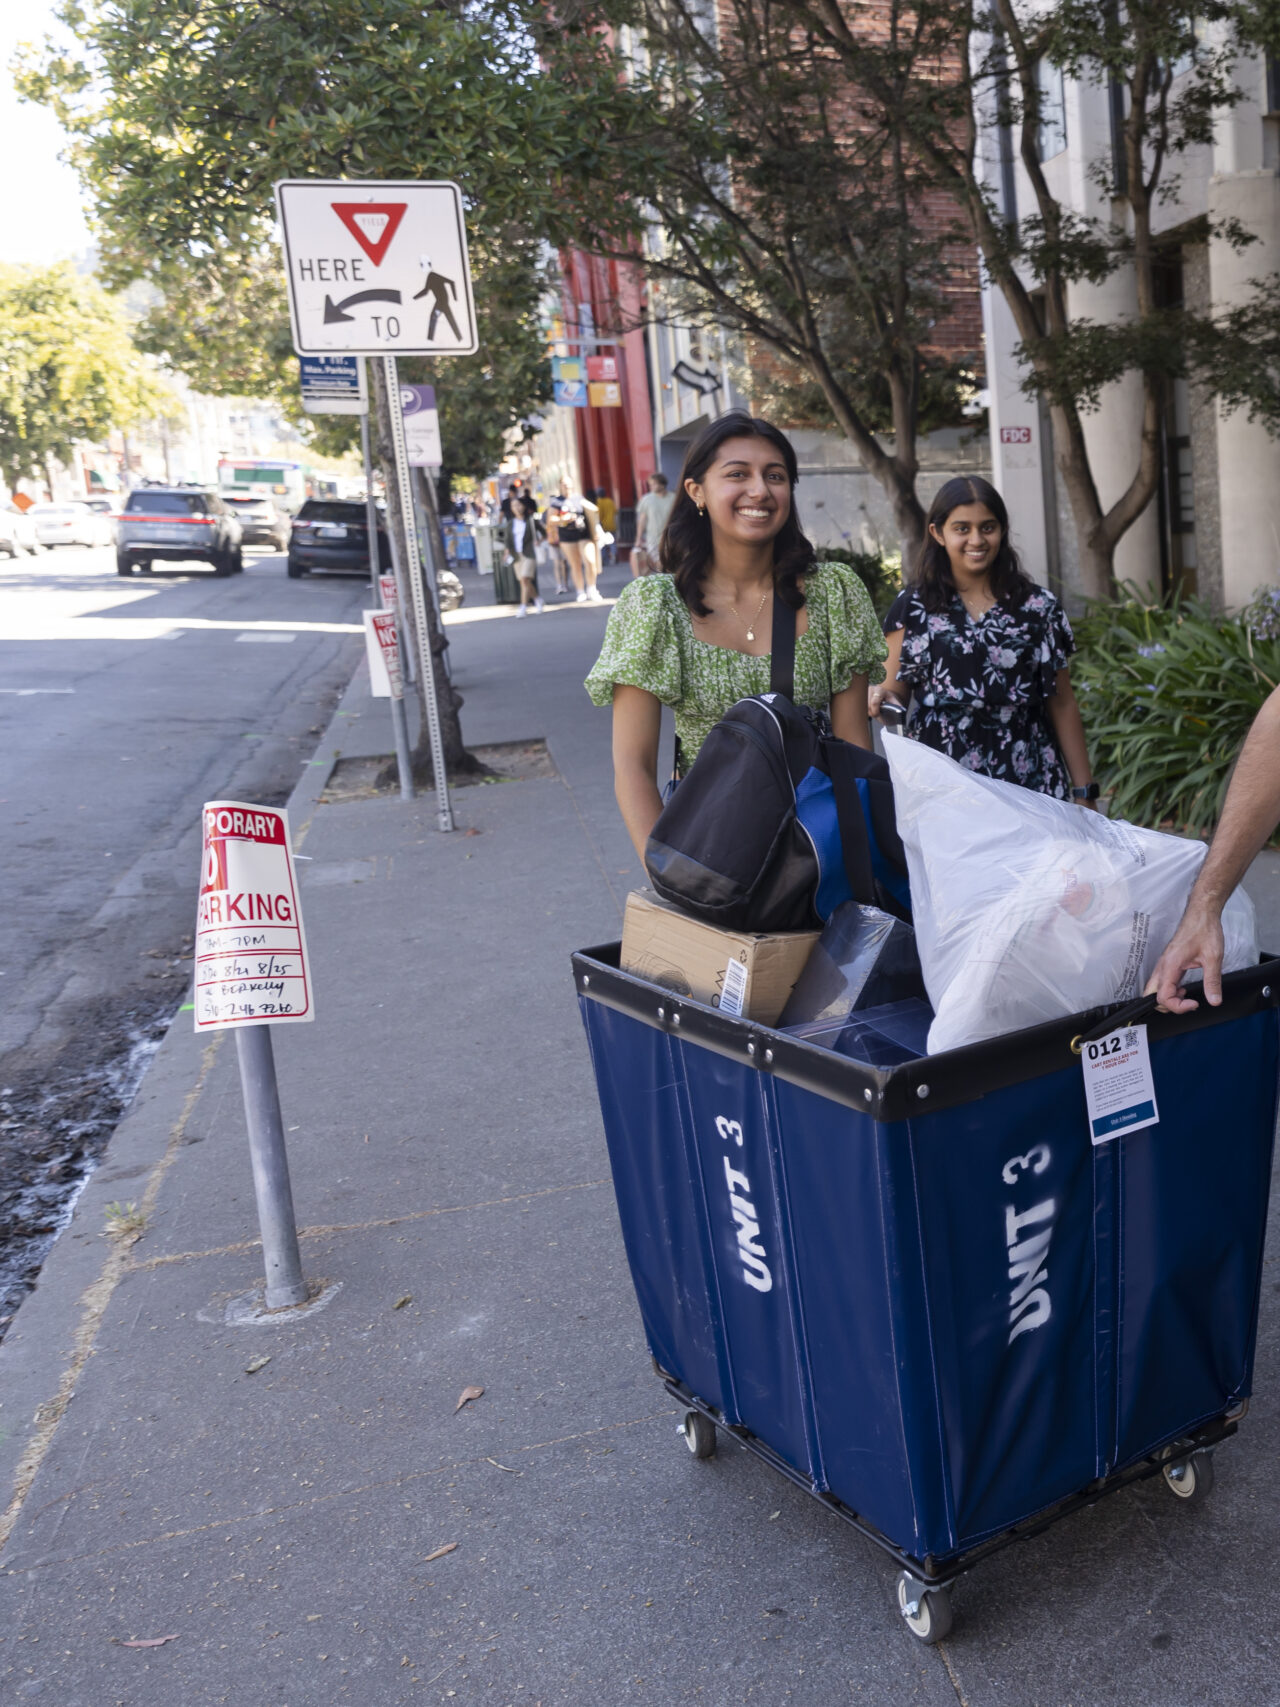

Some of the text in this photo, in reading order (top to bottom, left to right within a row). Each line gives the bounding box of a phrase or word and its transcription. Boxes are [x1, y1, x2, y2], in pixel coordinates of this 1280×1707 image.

[299, 258, 365, 281] HERE
[371, 316, 401, 338] TO
[1002, 429, 1030, 442] FDC
[257, 955, 292, 978] 8/25
[1088, 1036, 1122, 1060] 012
[714, 1115, 773, 1293] UNIT 3
[1002, 1143, 1055, 1345] UNIT 3
